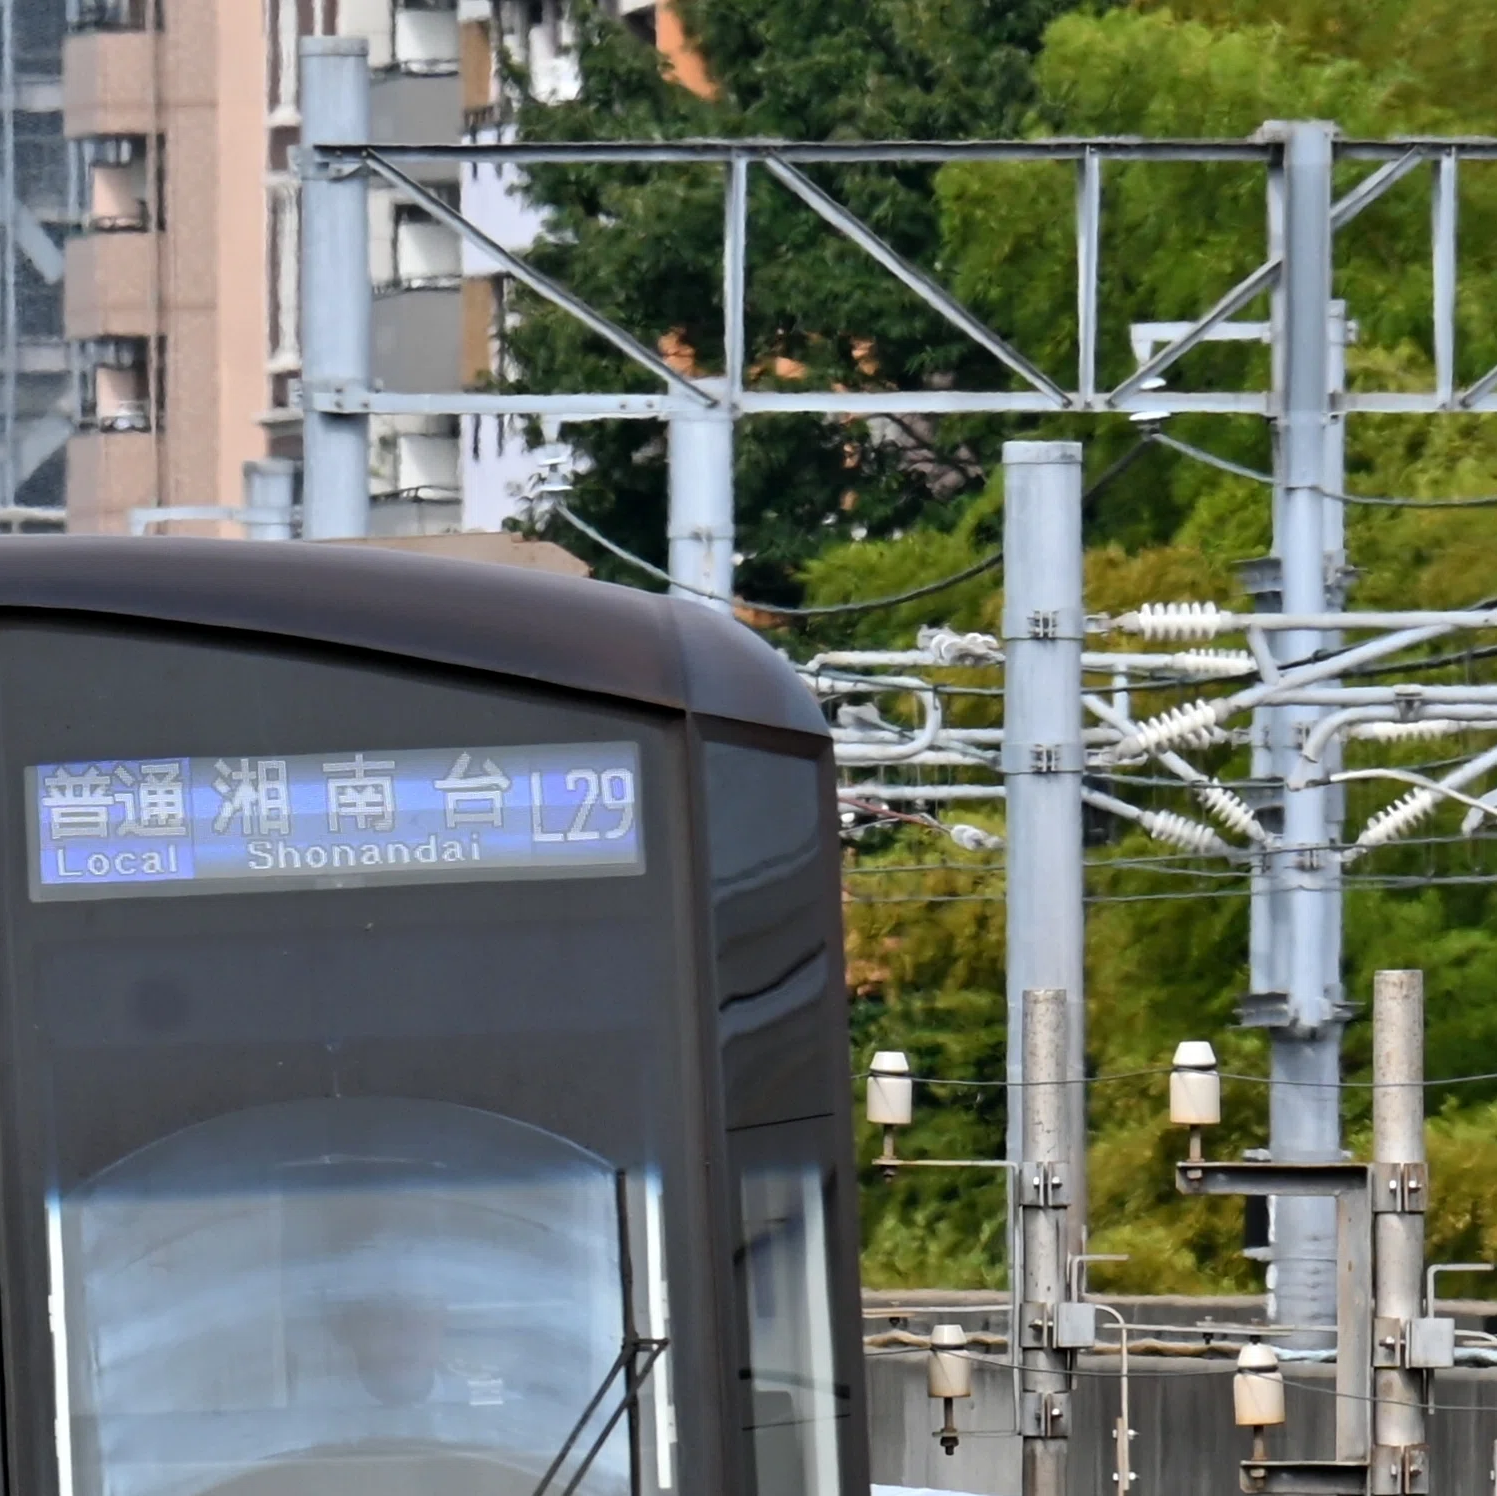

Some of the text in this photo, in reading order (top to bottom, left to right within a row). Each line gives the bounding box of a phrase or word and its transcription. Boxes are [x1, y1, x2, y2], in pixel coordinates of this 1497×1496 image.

[41, 751, 636, 843] 普通 湘南台 L29
[57, 833, 482, 878] Local Shonandai
